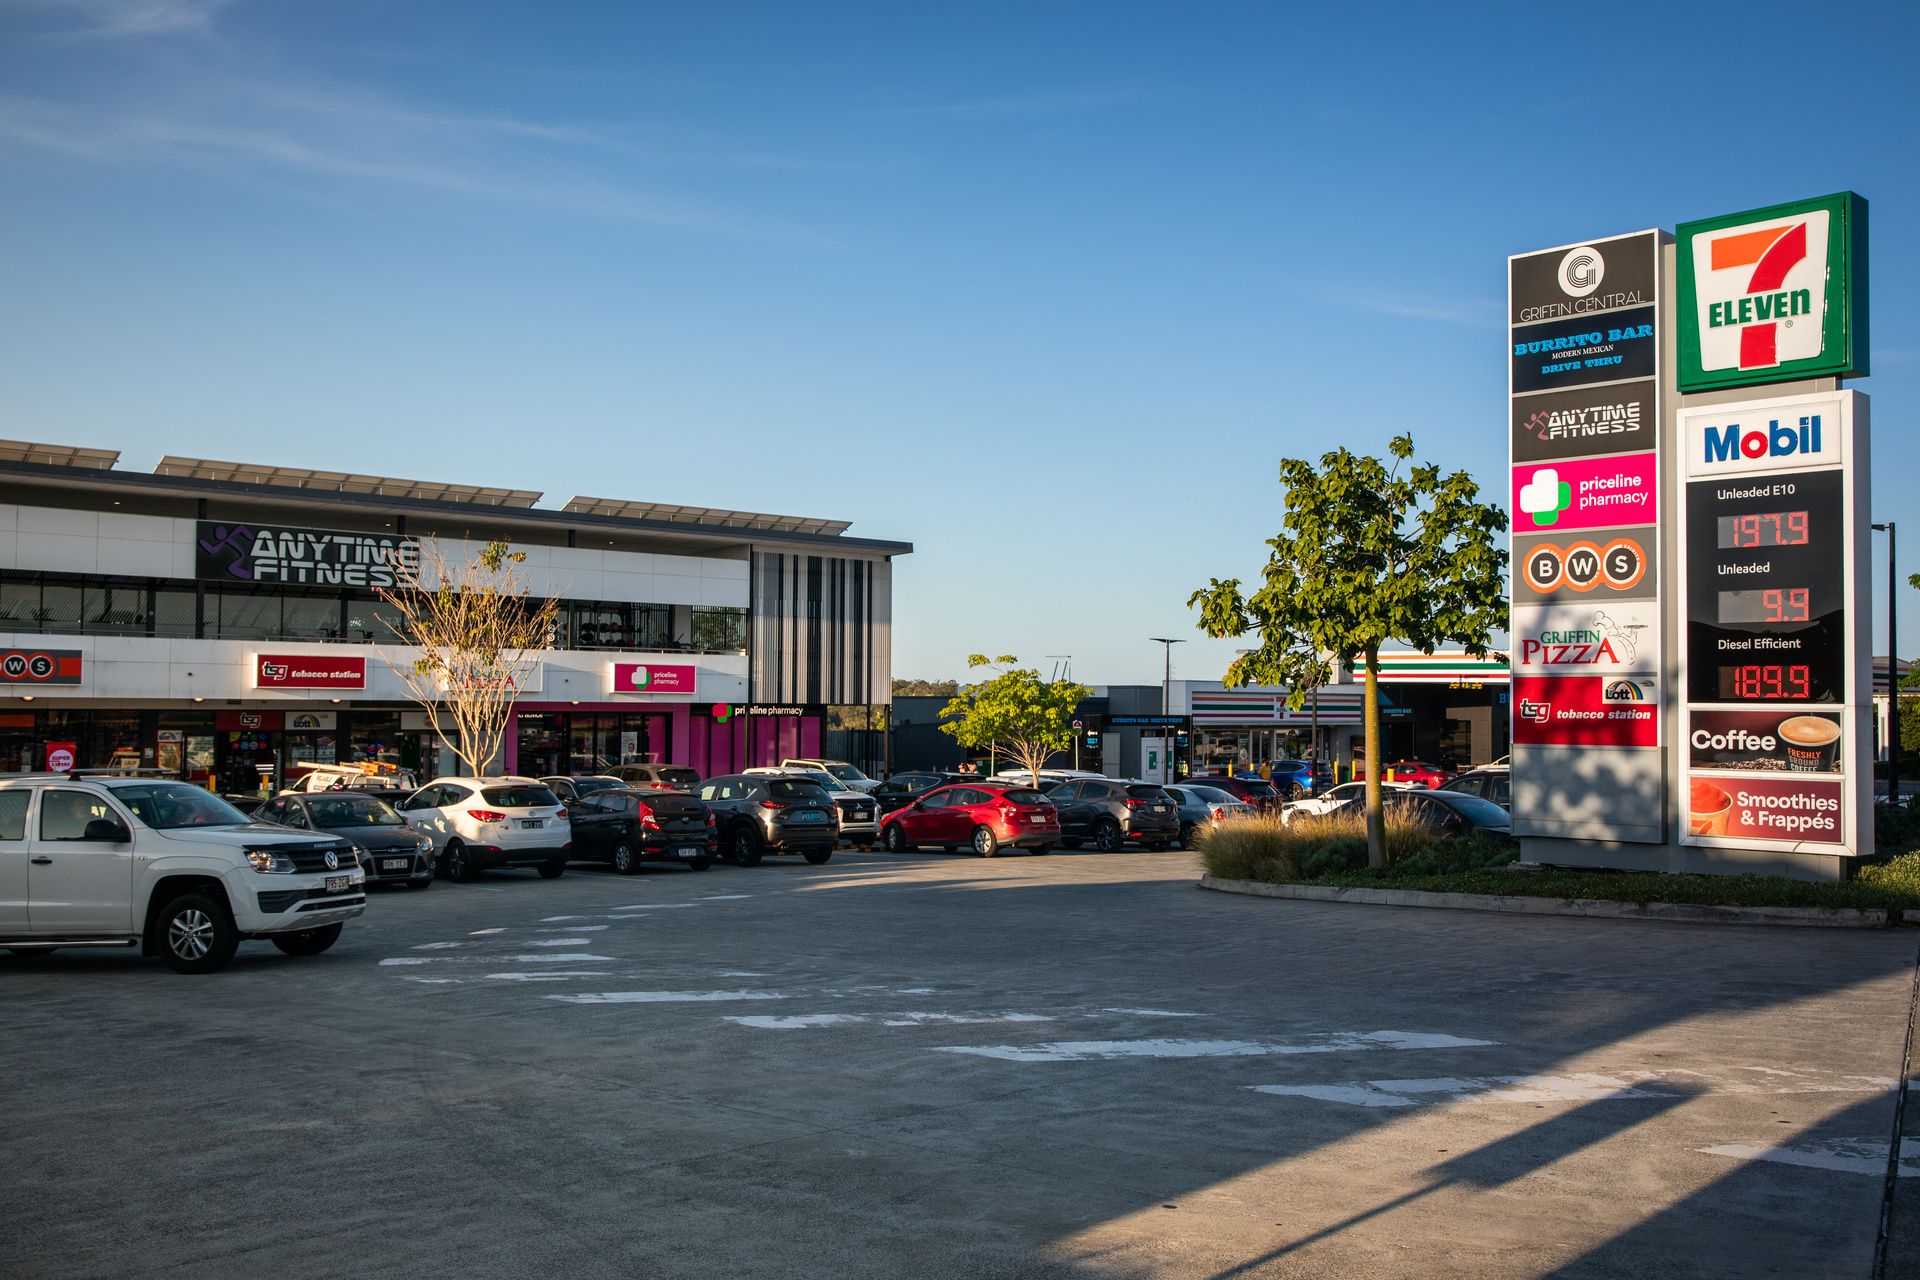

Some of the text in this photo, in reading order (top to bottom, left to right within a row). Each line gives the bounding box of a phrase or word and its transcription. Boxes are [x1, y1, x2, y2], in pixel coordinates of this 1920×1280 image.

[1520, 290, 1646, 321] GRIFFIN CENTRAL
[1514, 324, 1653, 356] BURRITO BAR
[1551, 344, 1614, 359] MODERN MEXICAN
[1541, 355, 1623, 374] DRIVE THRU
[1548, 402, 1640, 427] ANYTIME
[1549, 417, 1640, 440] FITNESS
[1704, 415, 1821, 463] Mobil
[1580, 473, 1642, 494] priceline
[1717, 484, 1795, 500] Unleaded E10
[1580, 492, 1648, 510] pharmacy
[1734, 511, 1809, 548] 197.9
[251, 531, 419, 566] ANYTIME
[254, 559, 419, 588] FITNESS
[1717, 562, 1770, 575] Unleaded
[1763, 588, 1809, 622] 9.9
[1541, 630, 1601, 644] GRIFFIN
[1718, 638, 1801, 650] Diesel Efficient
[262, 661, 288, 680] tsg
[330, 671, 361, 679] station
[1734, 665, 1809, 698] 189.9
[735, 706, 803, 716] prieline pharmacy
[1520, 698, 1551, 723] tsg
[1557, 709, 1651, 719] tobacco station
[1691, 730, 1776, 751] Coffee
[1788, 747, 1821, 759] FRESHLY
[1789, 756, 1819, 766] GROUND
[1737, 791, 1838, 811] Smoothies
[1740, 810, 1834, 832] & Frappés
